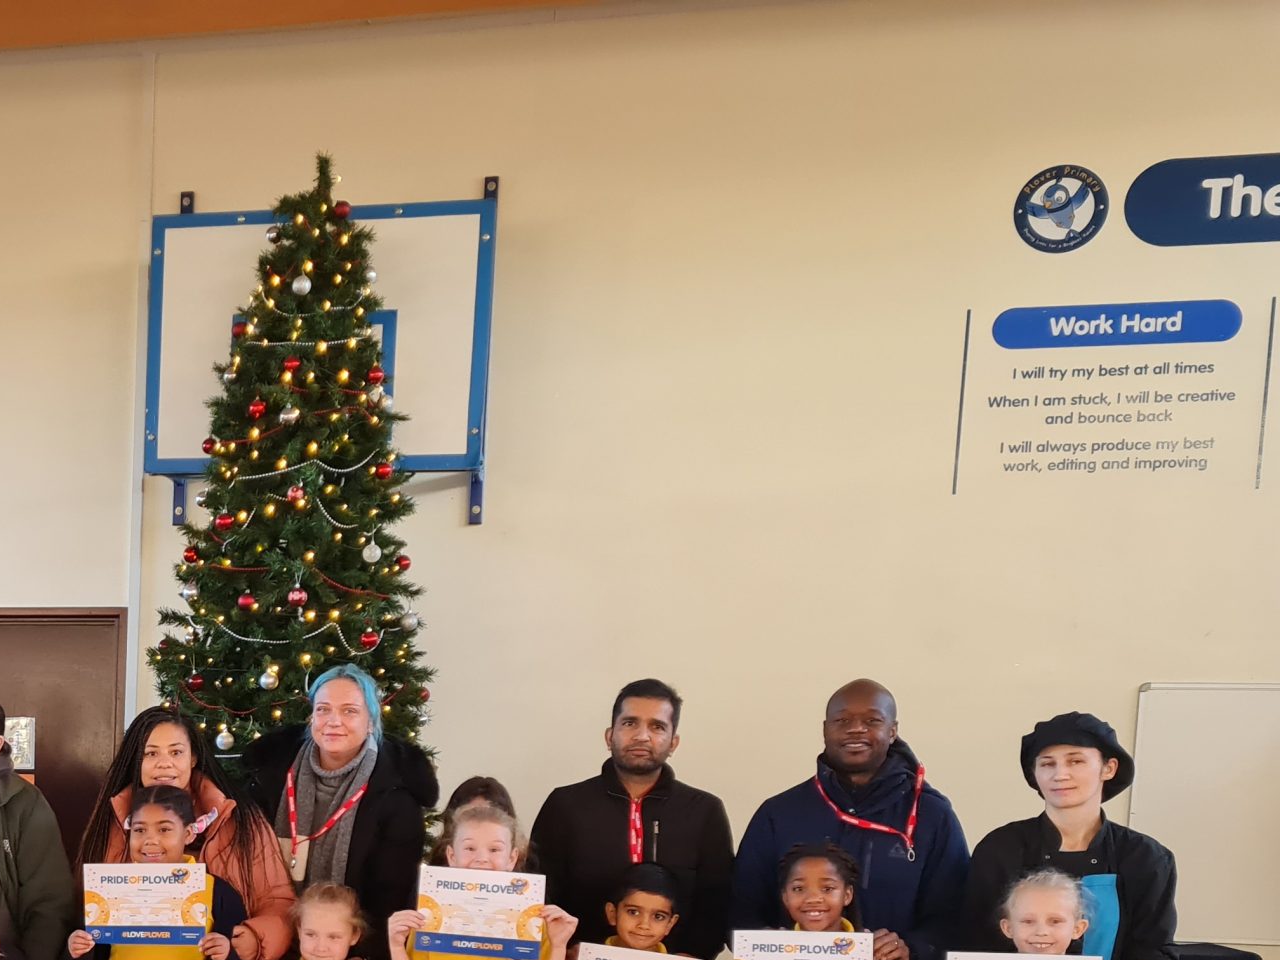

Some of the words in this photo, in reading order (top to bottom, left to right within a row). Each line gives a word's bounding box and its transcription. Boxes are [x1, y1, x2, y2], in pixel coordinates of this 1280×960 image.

[1064, 166, 1102, 192] Primary
[1049, 314, 1114, 337] Work
[1120, 311, 1183, 334] Hard
[1012, 367, 1017, 379] I
[1021, 366, 1044, 379] will
[1049, 366, 1067, 381] try
[1071, 367, 1095, 380] my
[1098, 364, 1130, 377] best
[1133, 363, 1150, 376] at
[1153, 362, 1170, 375] all
[1174, 361, 1215, 374] times
[988, 395, 1029, 408] When
[1034, 395, 1038, 407] I
[1042, 397, 1066, 407] am
[1070, 393, 1112, 407] stuck,
[1116, 392, 1121, 404] I
[1125, 391, 1149, 404] will
[1154, 390, 1173, 403] be
[1177, 389, 1236, 402] creative
[1045, 412, 1073, 425] and
[1077, 410, 1132, 424] bounce
[1136, 409, 1173, 422] back
[1000, 442, 1004, 453] I
[1008, 441, 1032, 453] will
[1036, 439, 1087, 455] always
[1091, 438, 1151, 454] produce
[1155, 439, 1179, 452] my
[1183, 436, 1215, 449] best
[1003, 459, 1042, 473] work,
[1047, 458, 1097, 473] editing
[1101, 457, 1130, 470] and
[1134, 456, 1208, 472] improving
